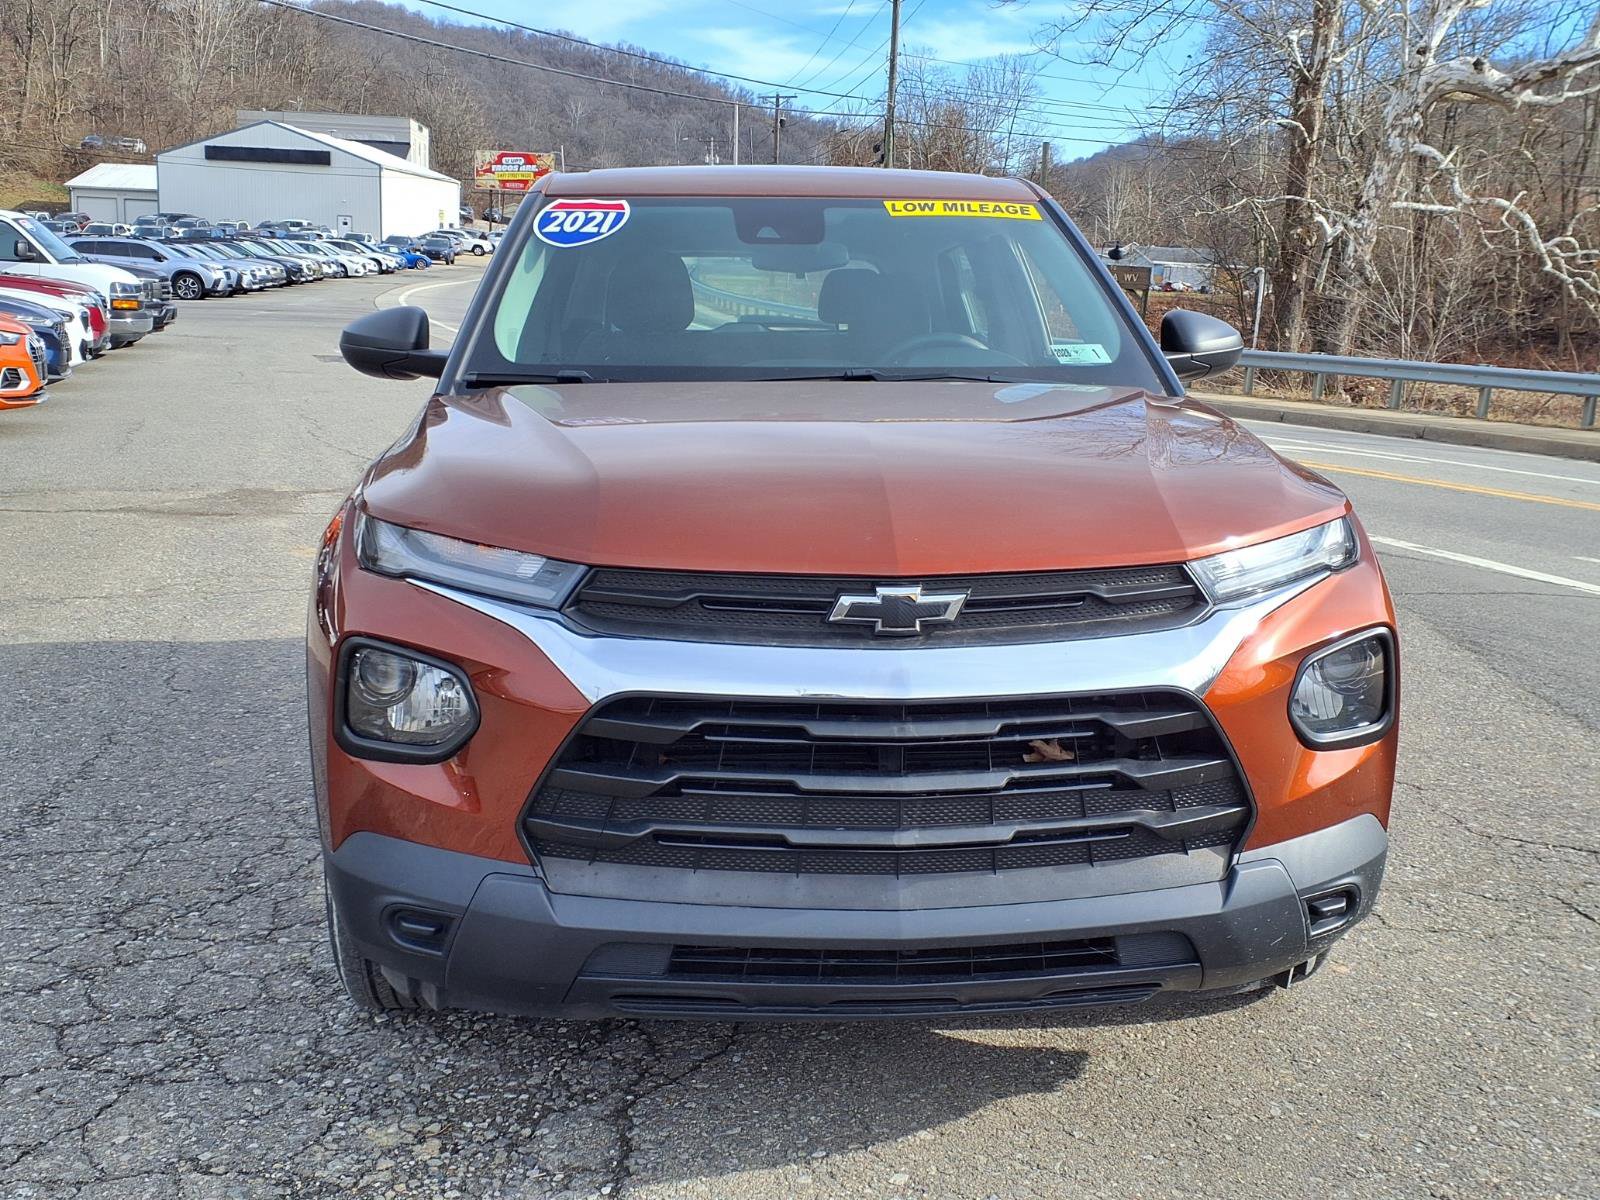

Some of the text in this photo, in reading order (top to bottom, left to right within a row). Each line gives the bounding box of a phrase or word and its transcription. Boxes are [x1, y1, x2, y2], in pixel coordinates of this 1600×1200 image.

[491, 164, 519, 172] TACOS
[891, 202, 1031, 216] LOW MILEAGE
[541, 211, 617, 234] 2021
[1124, 273, 1139, 282] WV
